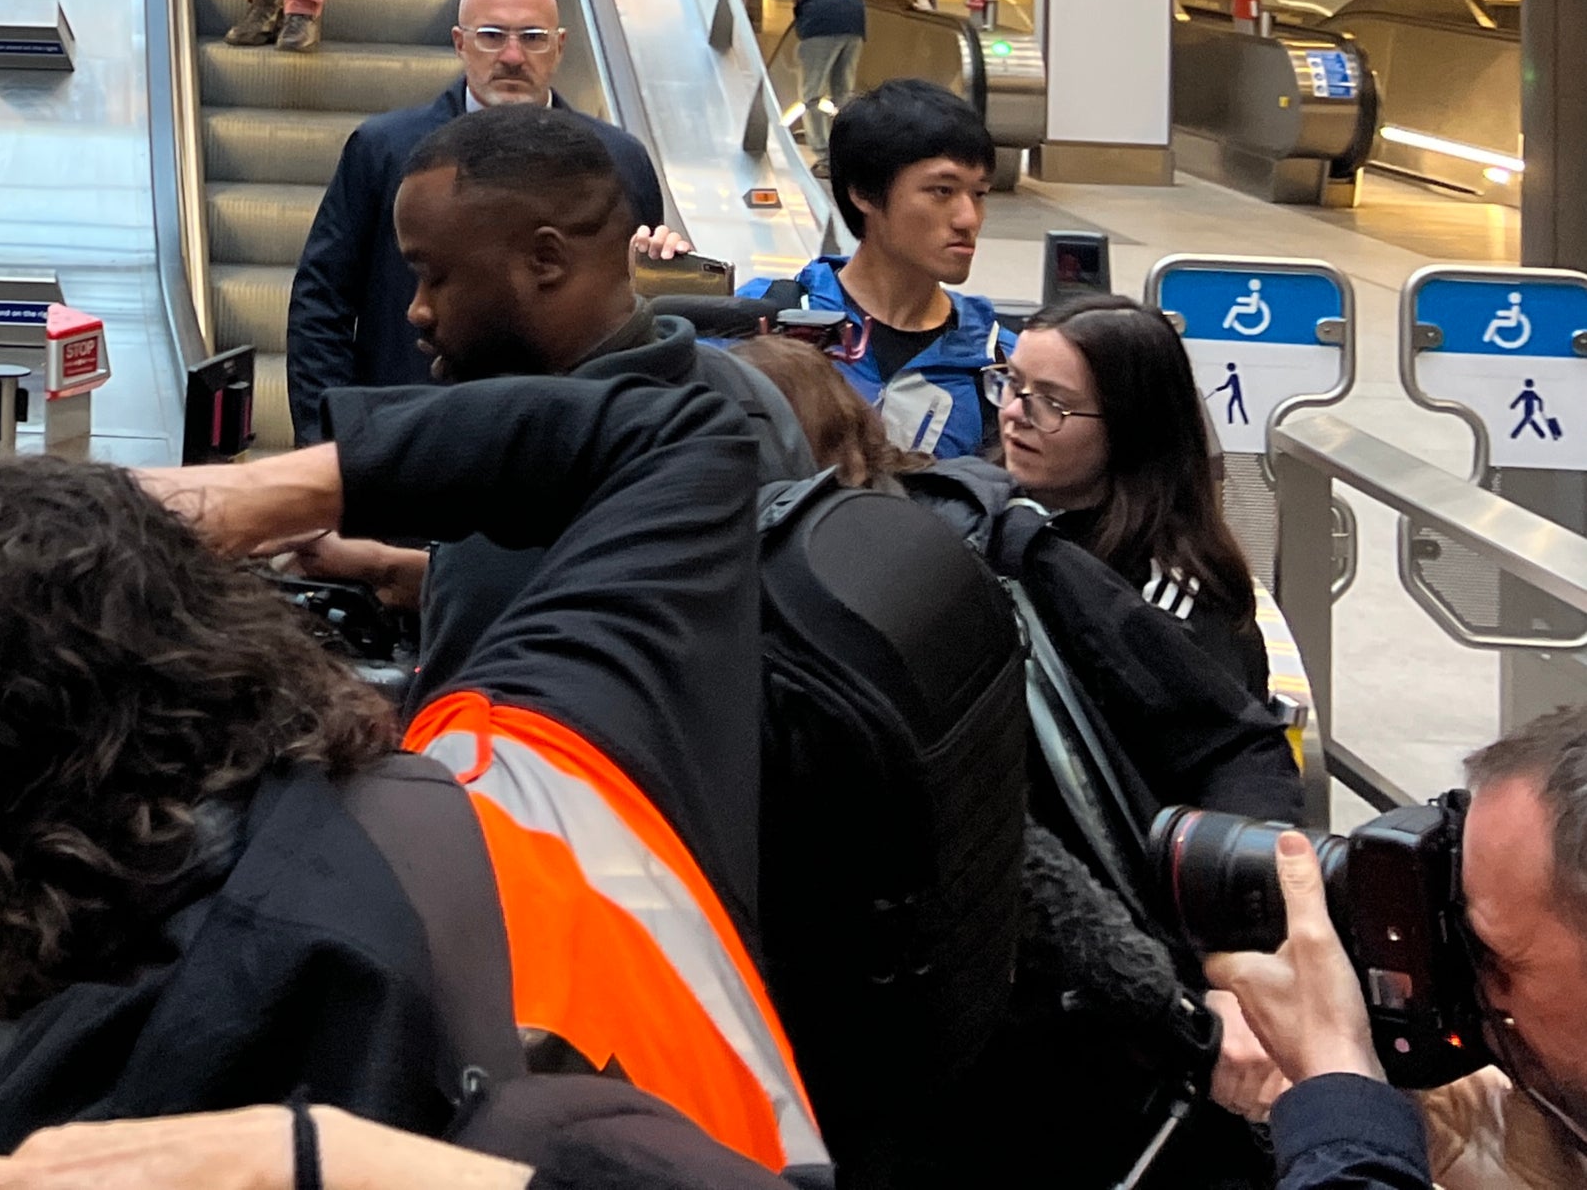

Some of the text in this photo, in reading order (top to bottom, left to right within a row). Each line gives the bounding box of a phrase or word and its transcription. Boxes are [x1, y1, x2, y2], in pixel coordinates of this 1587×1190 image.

[12, 310, 22, 318] on
[22, 310, 36, 318] the
[66, 340, 96, 359] STOP
